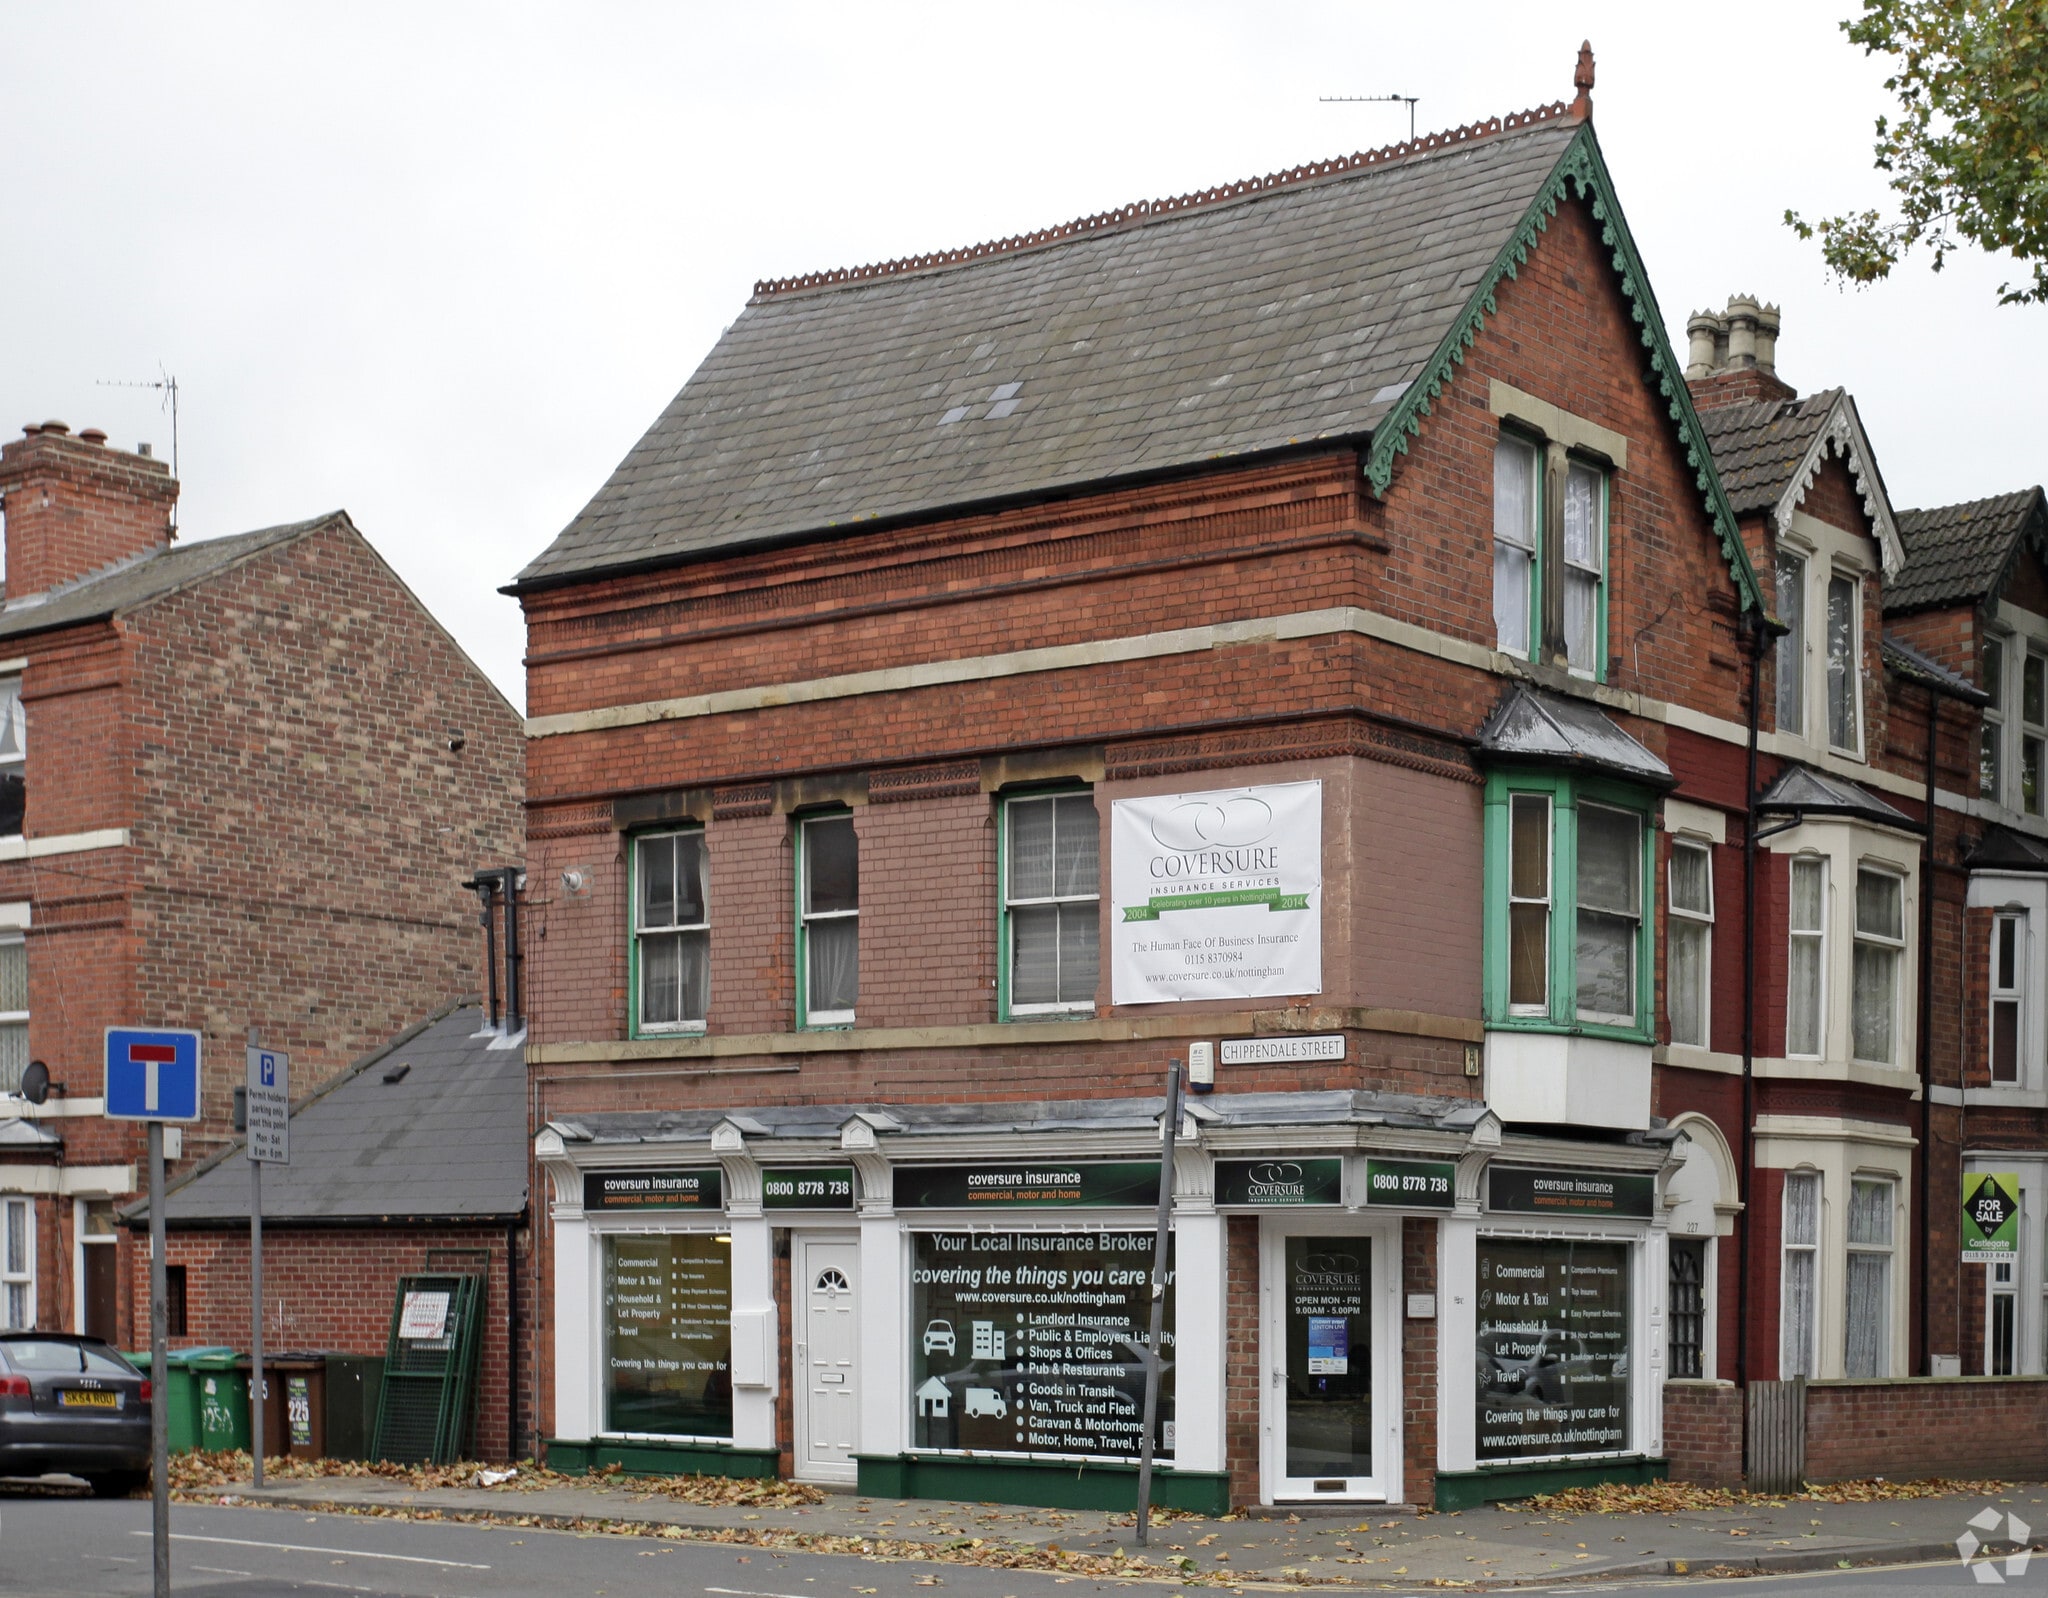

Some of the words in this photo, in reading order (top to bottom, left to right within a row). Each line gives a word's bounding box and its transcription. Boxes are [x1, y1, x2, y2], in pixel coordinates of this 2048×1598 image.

[1150, 846, 1278, 878] COVERSURE
[1150, 882, 1214, 895] INSURANCE
[1222, 878, 1280, 889] SERVICES
[1152, 897, 1187, 908] Celebrating
[1213, 896, 1231, 905] years
[1240, 893, 1277, 903] Nottingham
[1282, 897, 1303, 908] 2014
[1127, 909, 1147, 920] 2004
[1132, 942, 1147, 953] The
[1150, 941, 1180, 951] Human
[1183, 939, 1201, 950] Face
[1205, 937, 1216, 948] Of
[1218, 936, 1254, 947] Business
[1257, 933, 1299, 945] Insurance
[1185, 954, 1205, 965] 0115
[1145, 966, 1285, 983] www.coversure.co.uk/nottingham
[1223, 1043, 1297, 1059] CHIPPENDALE
[1302, 1040, 1340, 1055] STREET
[264, 1058, 272, 1082] P
[249, 1088, 266, 1100] Permit
[268, 1092, 286, 1103] holders
[251, 1104, 271, 1116] parking
[273, 1107, 283, 1117] only
[249, 1119, 261, 1128] past
[262, 1119, 272, 1129] this
[273, 1121, 287, 1131] point
[256, 1132, 267, 1142] Mon
[271, 1135, 281, 1145] Sat
[604, 1179, 650, 1190] coversure
[652, 1176, 699, 1189] insurance
[968, 1174, 1022, 1185] coversure
[1025, 1171, 1081, 1184] insurance
[1373, 1174, 1399, 1189] 0800
[1402, 1176, 1426, 1191] 8778
[1430, 1177, 1447, 1192] 738
[766, 1182, 793, 1195] 0800
[798, 1182, 824, 1195] 8778
[829, 1181, 849, 1195] 738
[1248, 1185, 1304, 1196] COVERSURE
[1534, 1179, 1574, 1192] coversure
[1575, 1179, 1614, 1194] insurance
[604, 1194, 644, 1204] commercial,
[645, 1195, 664, 1203] motor
[666, 1194, 678, 1202] and
[680, 1193, 699, 1202] home
[968, 1190, 1015, 1200] commercial,
[1016, 1191, 1039, 1199] motor
[1041, 1189, 1056, 1199] and
[1059, 1189, 1080, 1199] home
[1978, 1200, 2000, 1211] FOR
[1975, 1211, 2003, 1222] SALE
[1687, 1222, 1698, 1233] 227
[1985, 1226, 1993, 1234] by
[932, 1233, 966, 1250] Your
[972, 1233, 1012, 1250] Local
[1017, 1233, 1094, 1251] Insurance
[1100, 1233, 1154, 1251] Broker
[1969, 1238, 2009, 1249] Castlegate
[618, 1258, 658, 1267] Commercial
[912, 1265, 981, 1288] covering
[986, 1266, 1011, 1284] the
[1016, 1266, 1067, 1288] things
[1072, 1270, 1103, 1289] you
[1109, 1270, 1145, 1285] care
[1496, 1264, 1545, 1279] Commercial
[1571, 1266, 1596, 1275] Competitive
[1597, 1267, 1618, 1275] Premiums
[618, 1276, 637, 1285] Motor
[640, 1277, 645, 1285] &
[647, 1276, 661, 1285] Taxi
[1296, 1274, 1360, 1285] COVERSURE
[618, 1294, 654, 1303] Household
[656, 1295, 661, 1304] &
[955, 1291, 1126, 1307] www.coversure.co.uk/nottingham
[1495, 1292, 1520, 1305] Motor
[1523, 1293, 1529, 1305] &
[1532, 1293, 1549, 1305] Taxi
[1571, 1288, 1579, 1296] Top
[1580, 1288, 1597, 1296] Insurers
[1295, 1296, 1319, 1304] OPEN
[1321, 1296, 1340, 1304] MON
[618, 1309, 629, 1318] Let
[631, 1309, 660, 1320] Property
[1296, 1306, 1325, 1314] 9.00AM
[1571, 1310, 1582, 1318] Easy
[1582, 1310, 1601, 1318] Payment
[1602, 1310, 1621, 1318] Schemes
[1029, 1312, 1075, 1326] Landlord
[1078, 1313, 1130, 1326] Insurance
[619, 1326, 638, 1336] Travel
[1495, 1320, 1538, 1333] Household
[1542, 1320, 1548, 1333] &
[1029, 1329, 1061, 1342] Public
[1064, 1330, 1072, 1342] &
[1075, 1330, 1131, 1346] Employers
[1134, 1331, 1176, 1347] Liality
[1029, 1345, 1062, 1361] Shops
[1064, 1347, 1073, 1359] &
[1075, 1347, 1113, 1359] Offices
[1495, 1342, 1508, 1355] Let
[1512, 1342, 1547, 1357] Property
[611, 1357, 641, 1369] Covering
[644, 1359, 655, 1368] the
[658, 1359, 679, 1370] things
[682, 1361, 695, 1370] you
[698, 1362, 714, 1370] care
[716, 1360, 727, 1370] for
[1029, 1362, 1049, 1374] Pub
[1052, 1363, 1060, 1375] &
[1063, 1363, 1126, 1377] Restaurants
[1496, 1369, 1520, 1383] Travel
[248, 1379, 268, 1400] 25
[1029, 1383, 1063, 1396] Goods
[1066, 1383, 1076, 1396] in
[1078, 1384, 1115, 1397] Transit
[65, 1391, 91, 1404] SK54
[288, 1401, 309, 1422] 225
[1029, 1400, 1052, 1414] Van,
[1054, 1400, 1084, 1413] Truck
[1086, 1401, 1106, 1414] and
[1109, 1402, 1135, 1415] Fleet
[1485, 1409, 1523, 1424] Covering
[1527, 1408, 1539, 1421] the
[1543, 1408, 1568, 1422] things
[1571, 1409, 1586, 1421] you
[1588, 1408, 1606, 1418] care
[1609, 1405, 1620, 1417] for
[1029, 1416, 1071, 1429] Caravan
[1074, 1418, 1082, 1430] &
[1028, 1432, 1061, 1447] Motor,
[1064, 1434, 1097, 1449] Home,
[1100, 1435, 1135, 1450] Travel,
[1483, 1427, 1622, 1447] www.coversure.co.uk/nottingham
